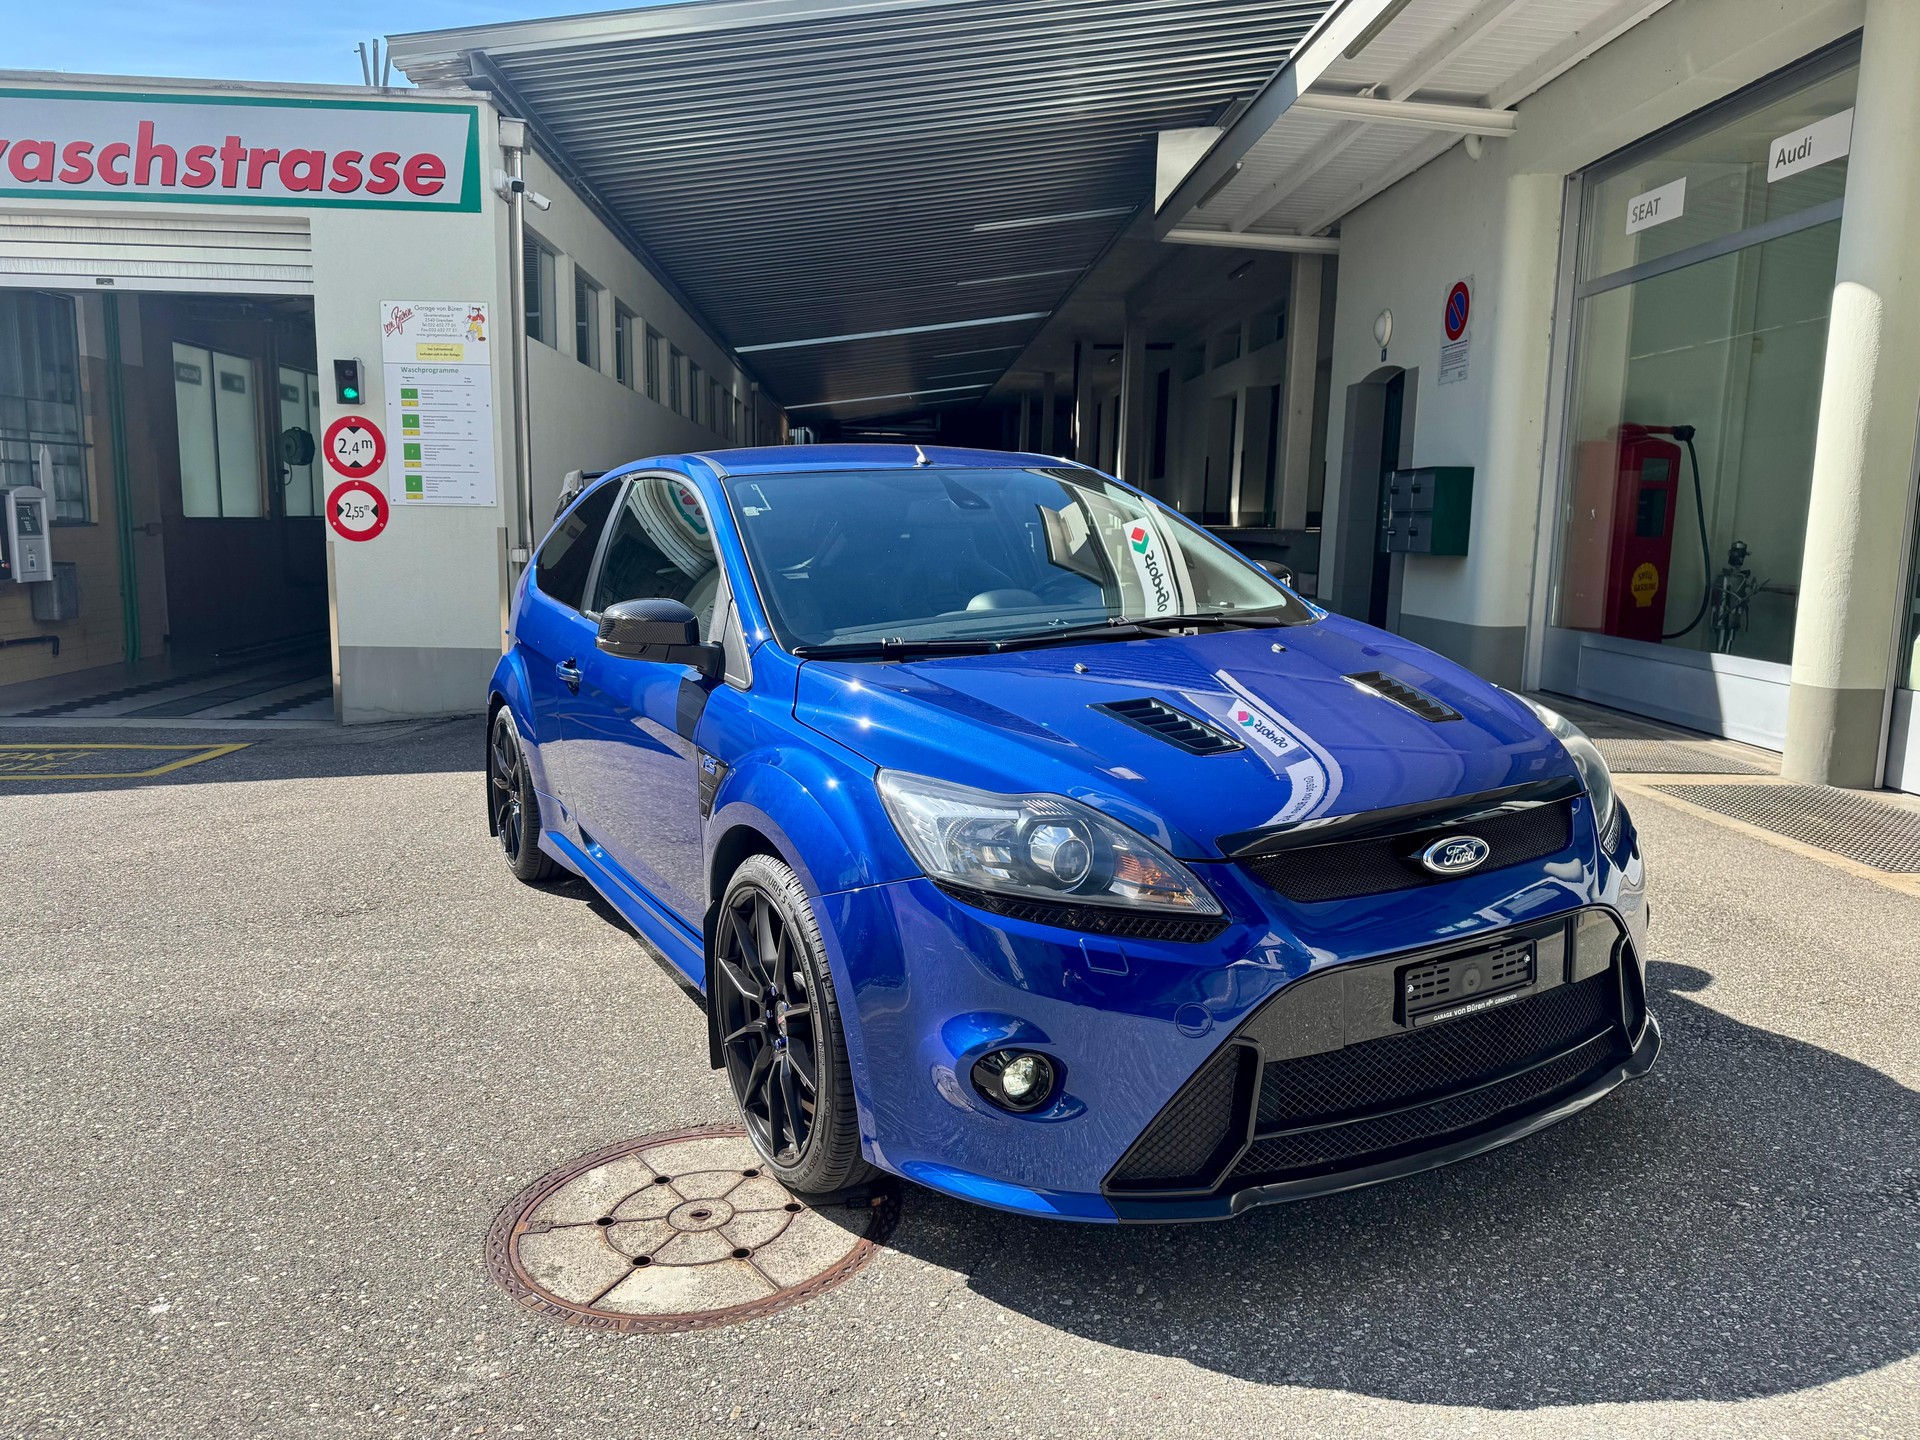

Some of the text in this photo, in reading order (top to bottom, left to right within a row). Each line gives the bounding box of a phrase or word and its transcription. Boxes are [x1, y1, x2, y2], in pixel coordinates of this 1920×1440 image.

[0, 120, 446, 196] aschstrasse
[1775, 136, 1813, 169] Audi
[1632, 197, 1661, 224] SEAT
[401, 366, 459, 375] Waschprogramme
[1443, 843, 1477, 866] Ford
[1433, 1012, 1453, 1022] GARAGE
[1453, 1007, 1466, 1016] von
[1466, 1002, 1486, 1013] Büren
[577, 1314, 621, 1330] VON
